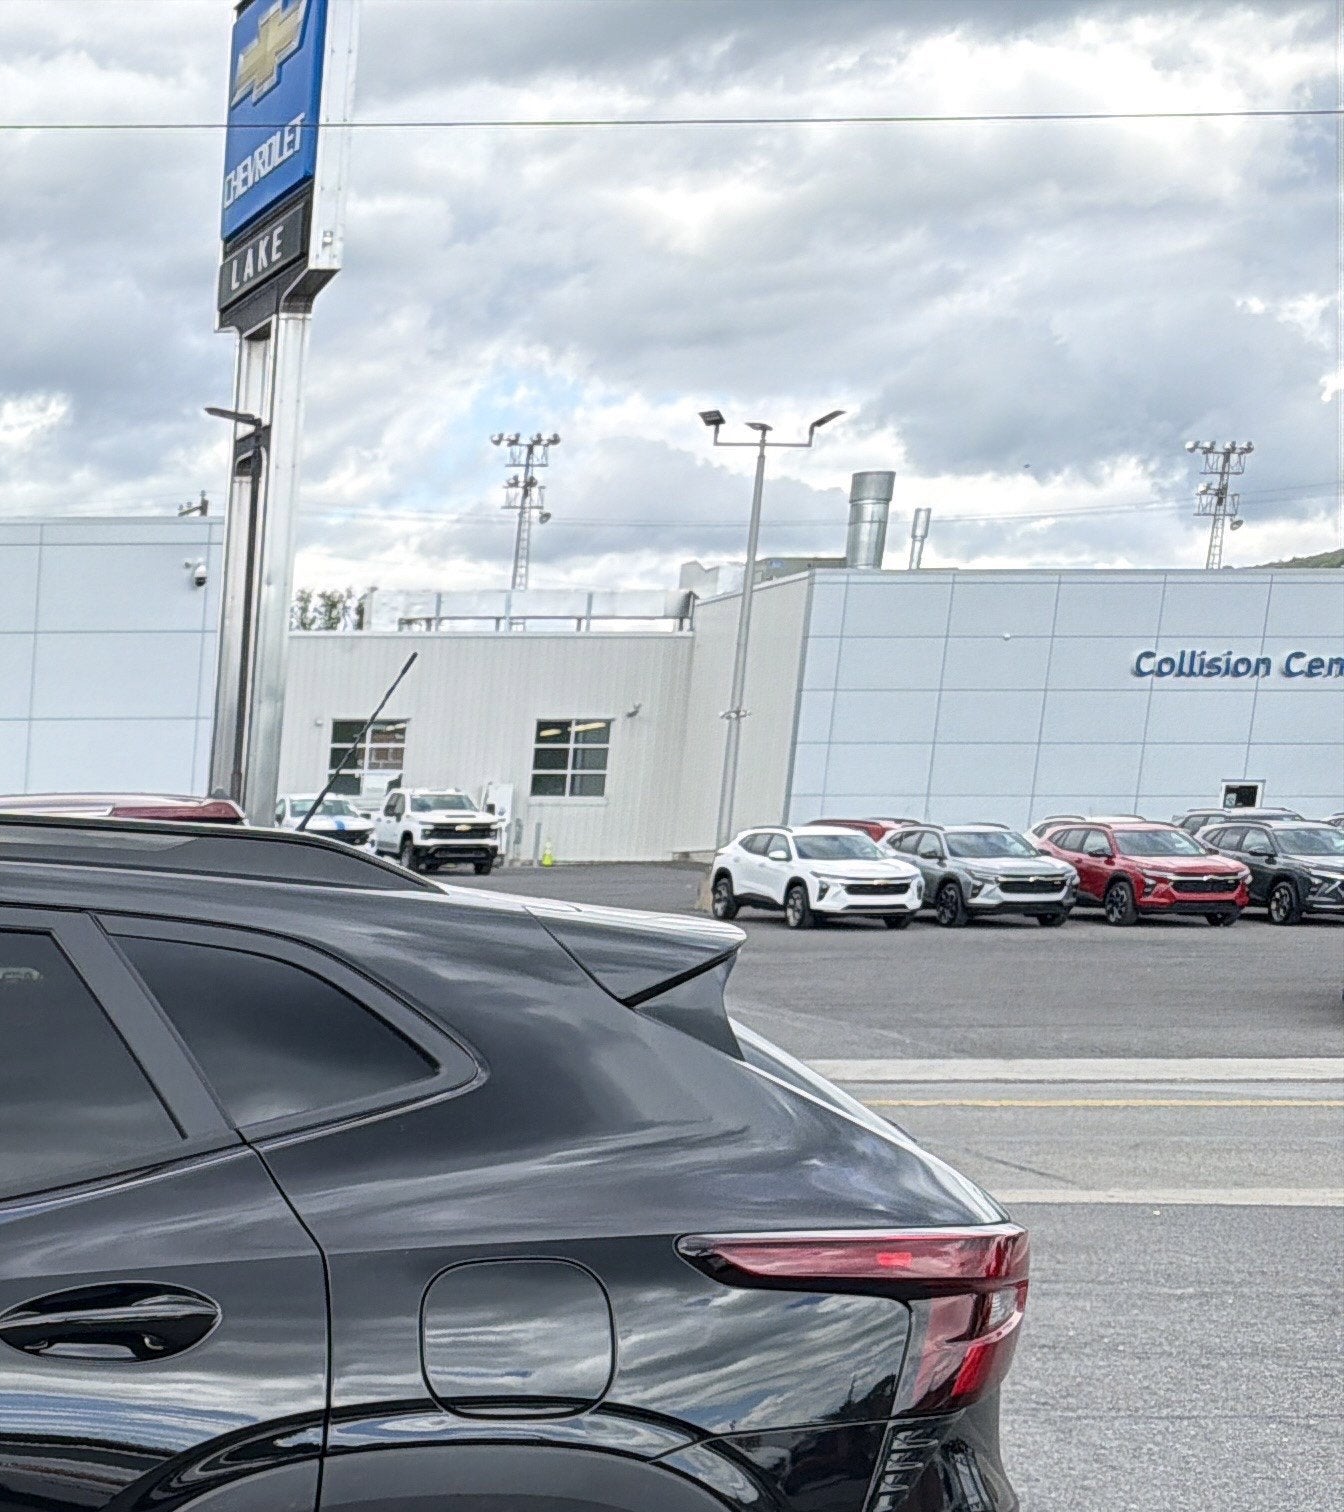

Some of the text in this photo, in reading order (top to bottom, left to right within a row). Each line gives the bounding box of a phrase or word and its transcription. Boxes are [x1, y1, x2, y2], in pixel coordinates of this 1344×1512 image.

[223, 113, 306, 209] CHEVROLET
[230, 225, 284, 291] LAKE
[1133, 649, 1272, 678] Collision
